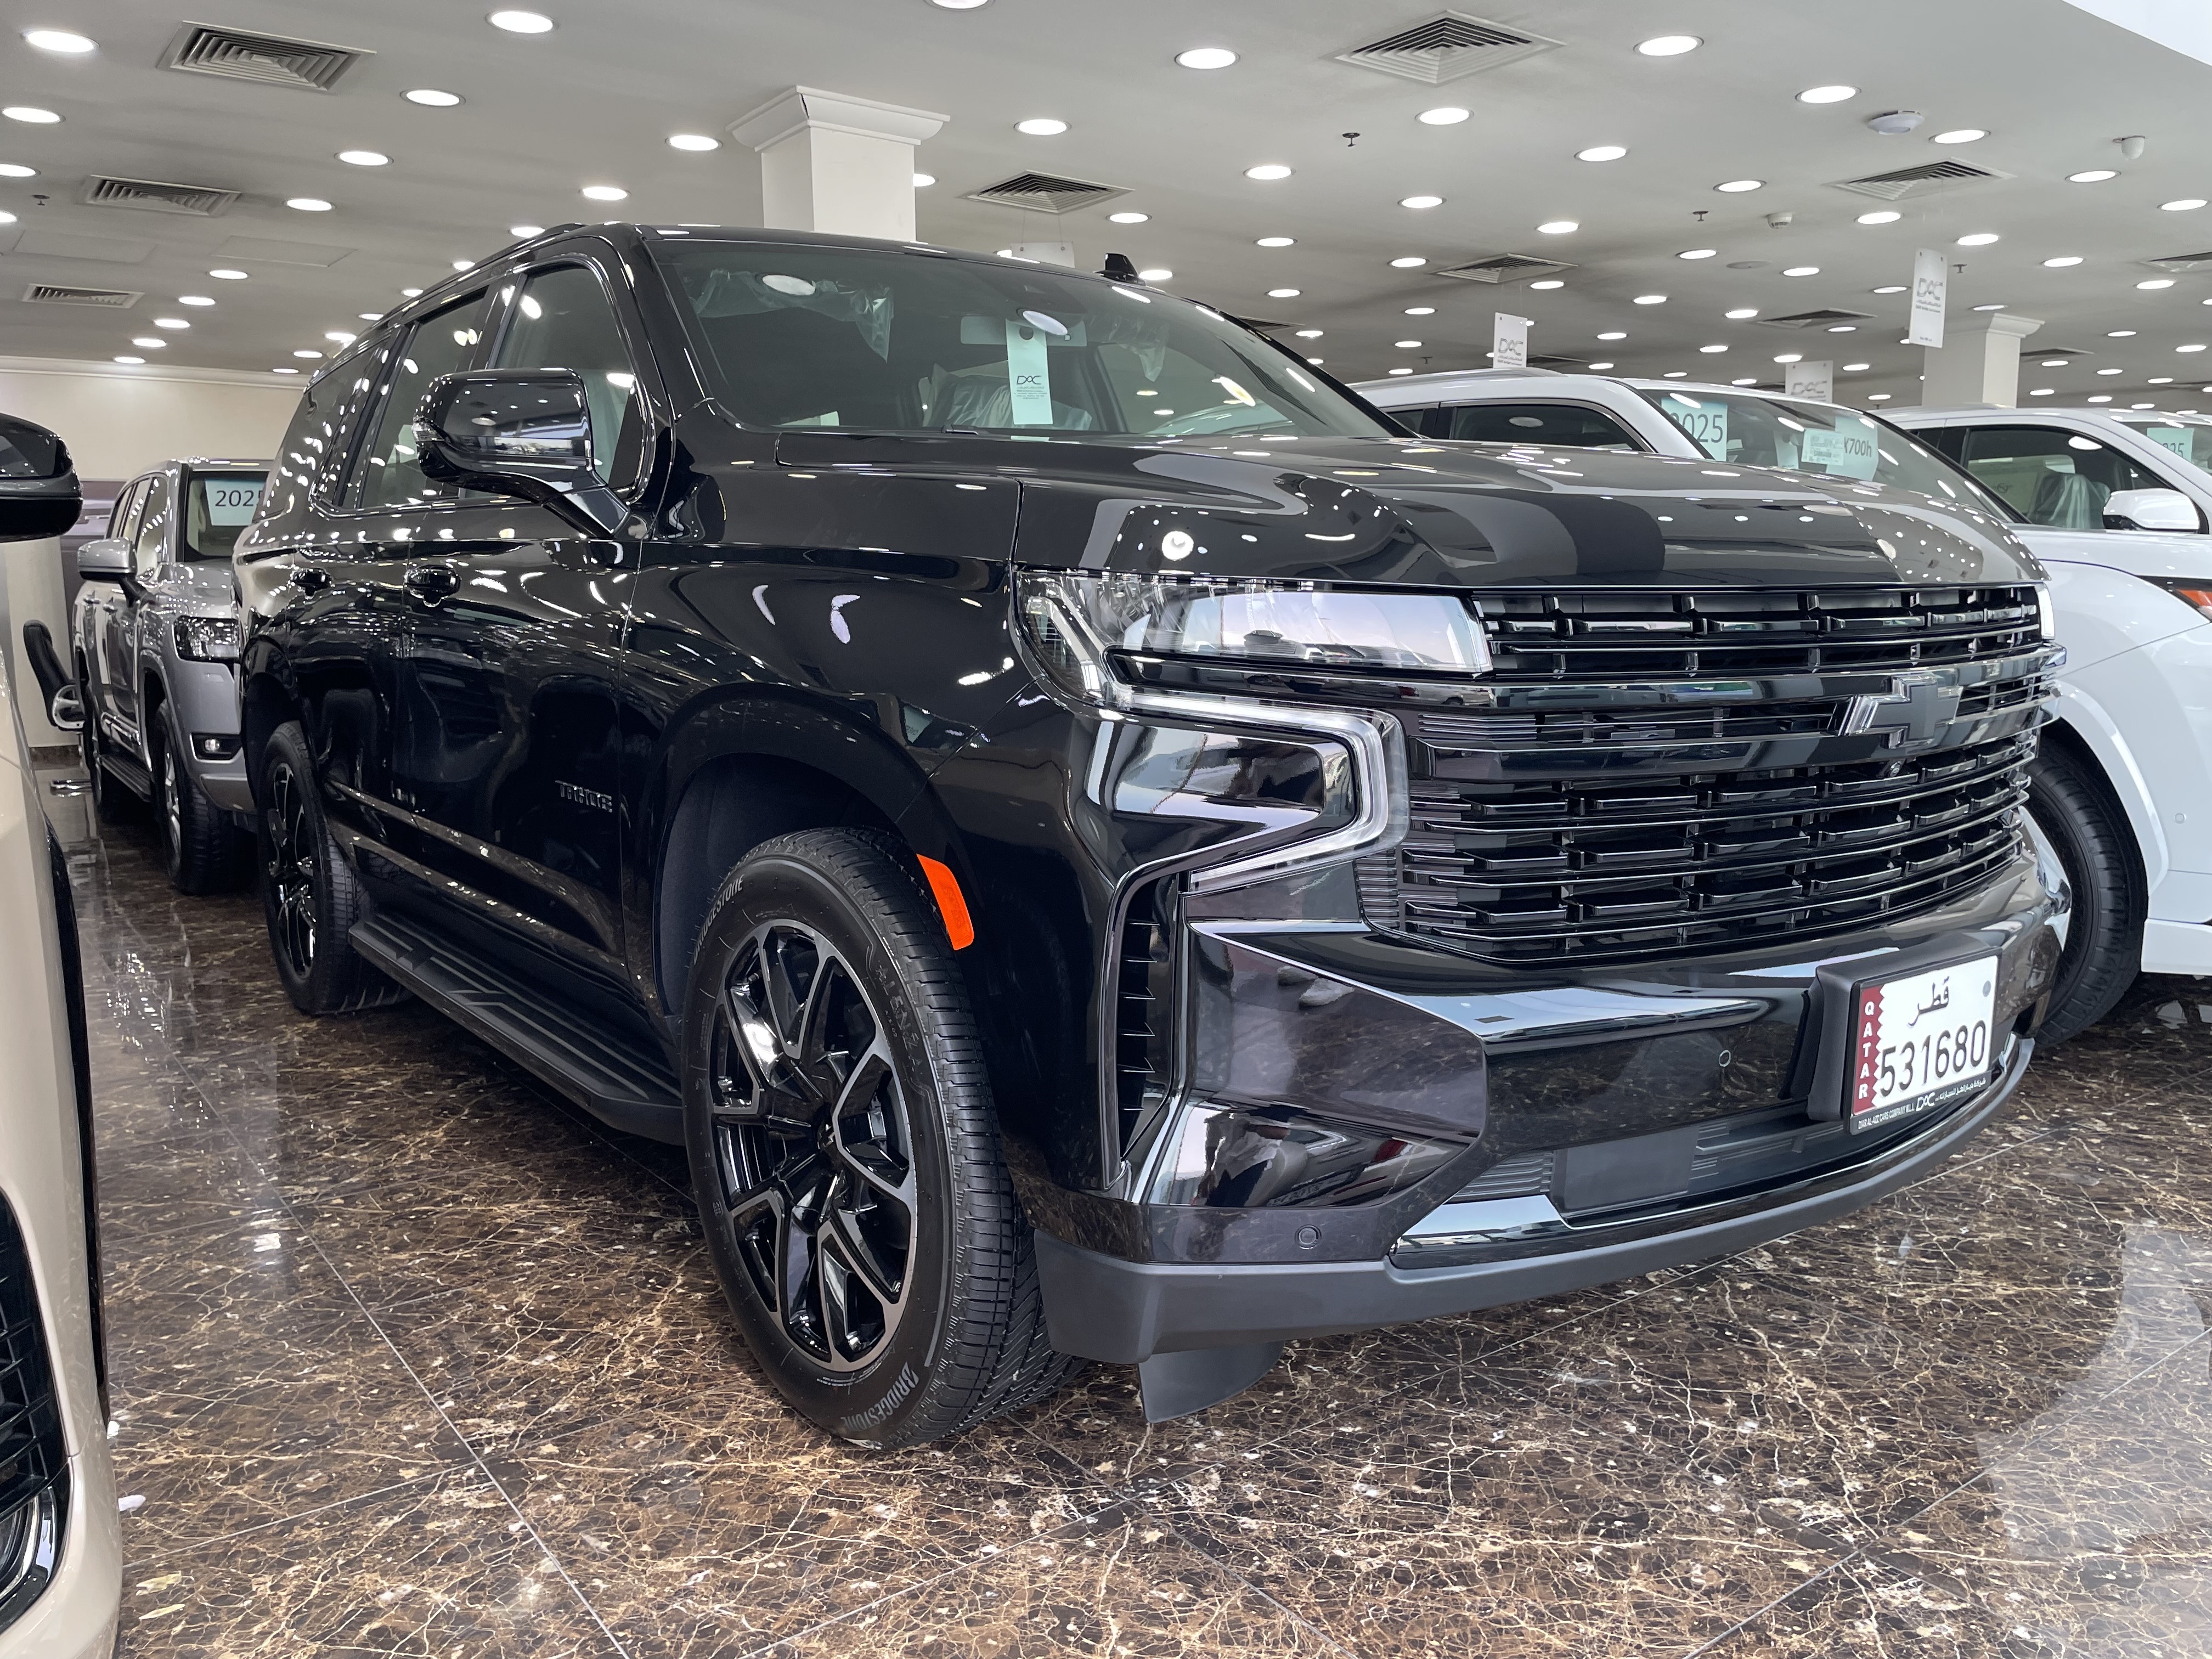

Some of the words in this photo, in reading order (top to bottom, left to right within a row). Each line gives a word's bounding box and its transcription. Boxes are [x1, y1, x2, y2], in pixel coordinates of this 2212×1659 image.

[215, 490, 262, 507] 202
[1908, 976, 1950, 1027] قطر
[1859, 1002, 1875, 1099] QATAR
[1880, 1020, 1986, 1097] 531680
